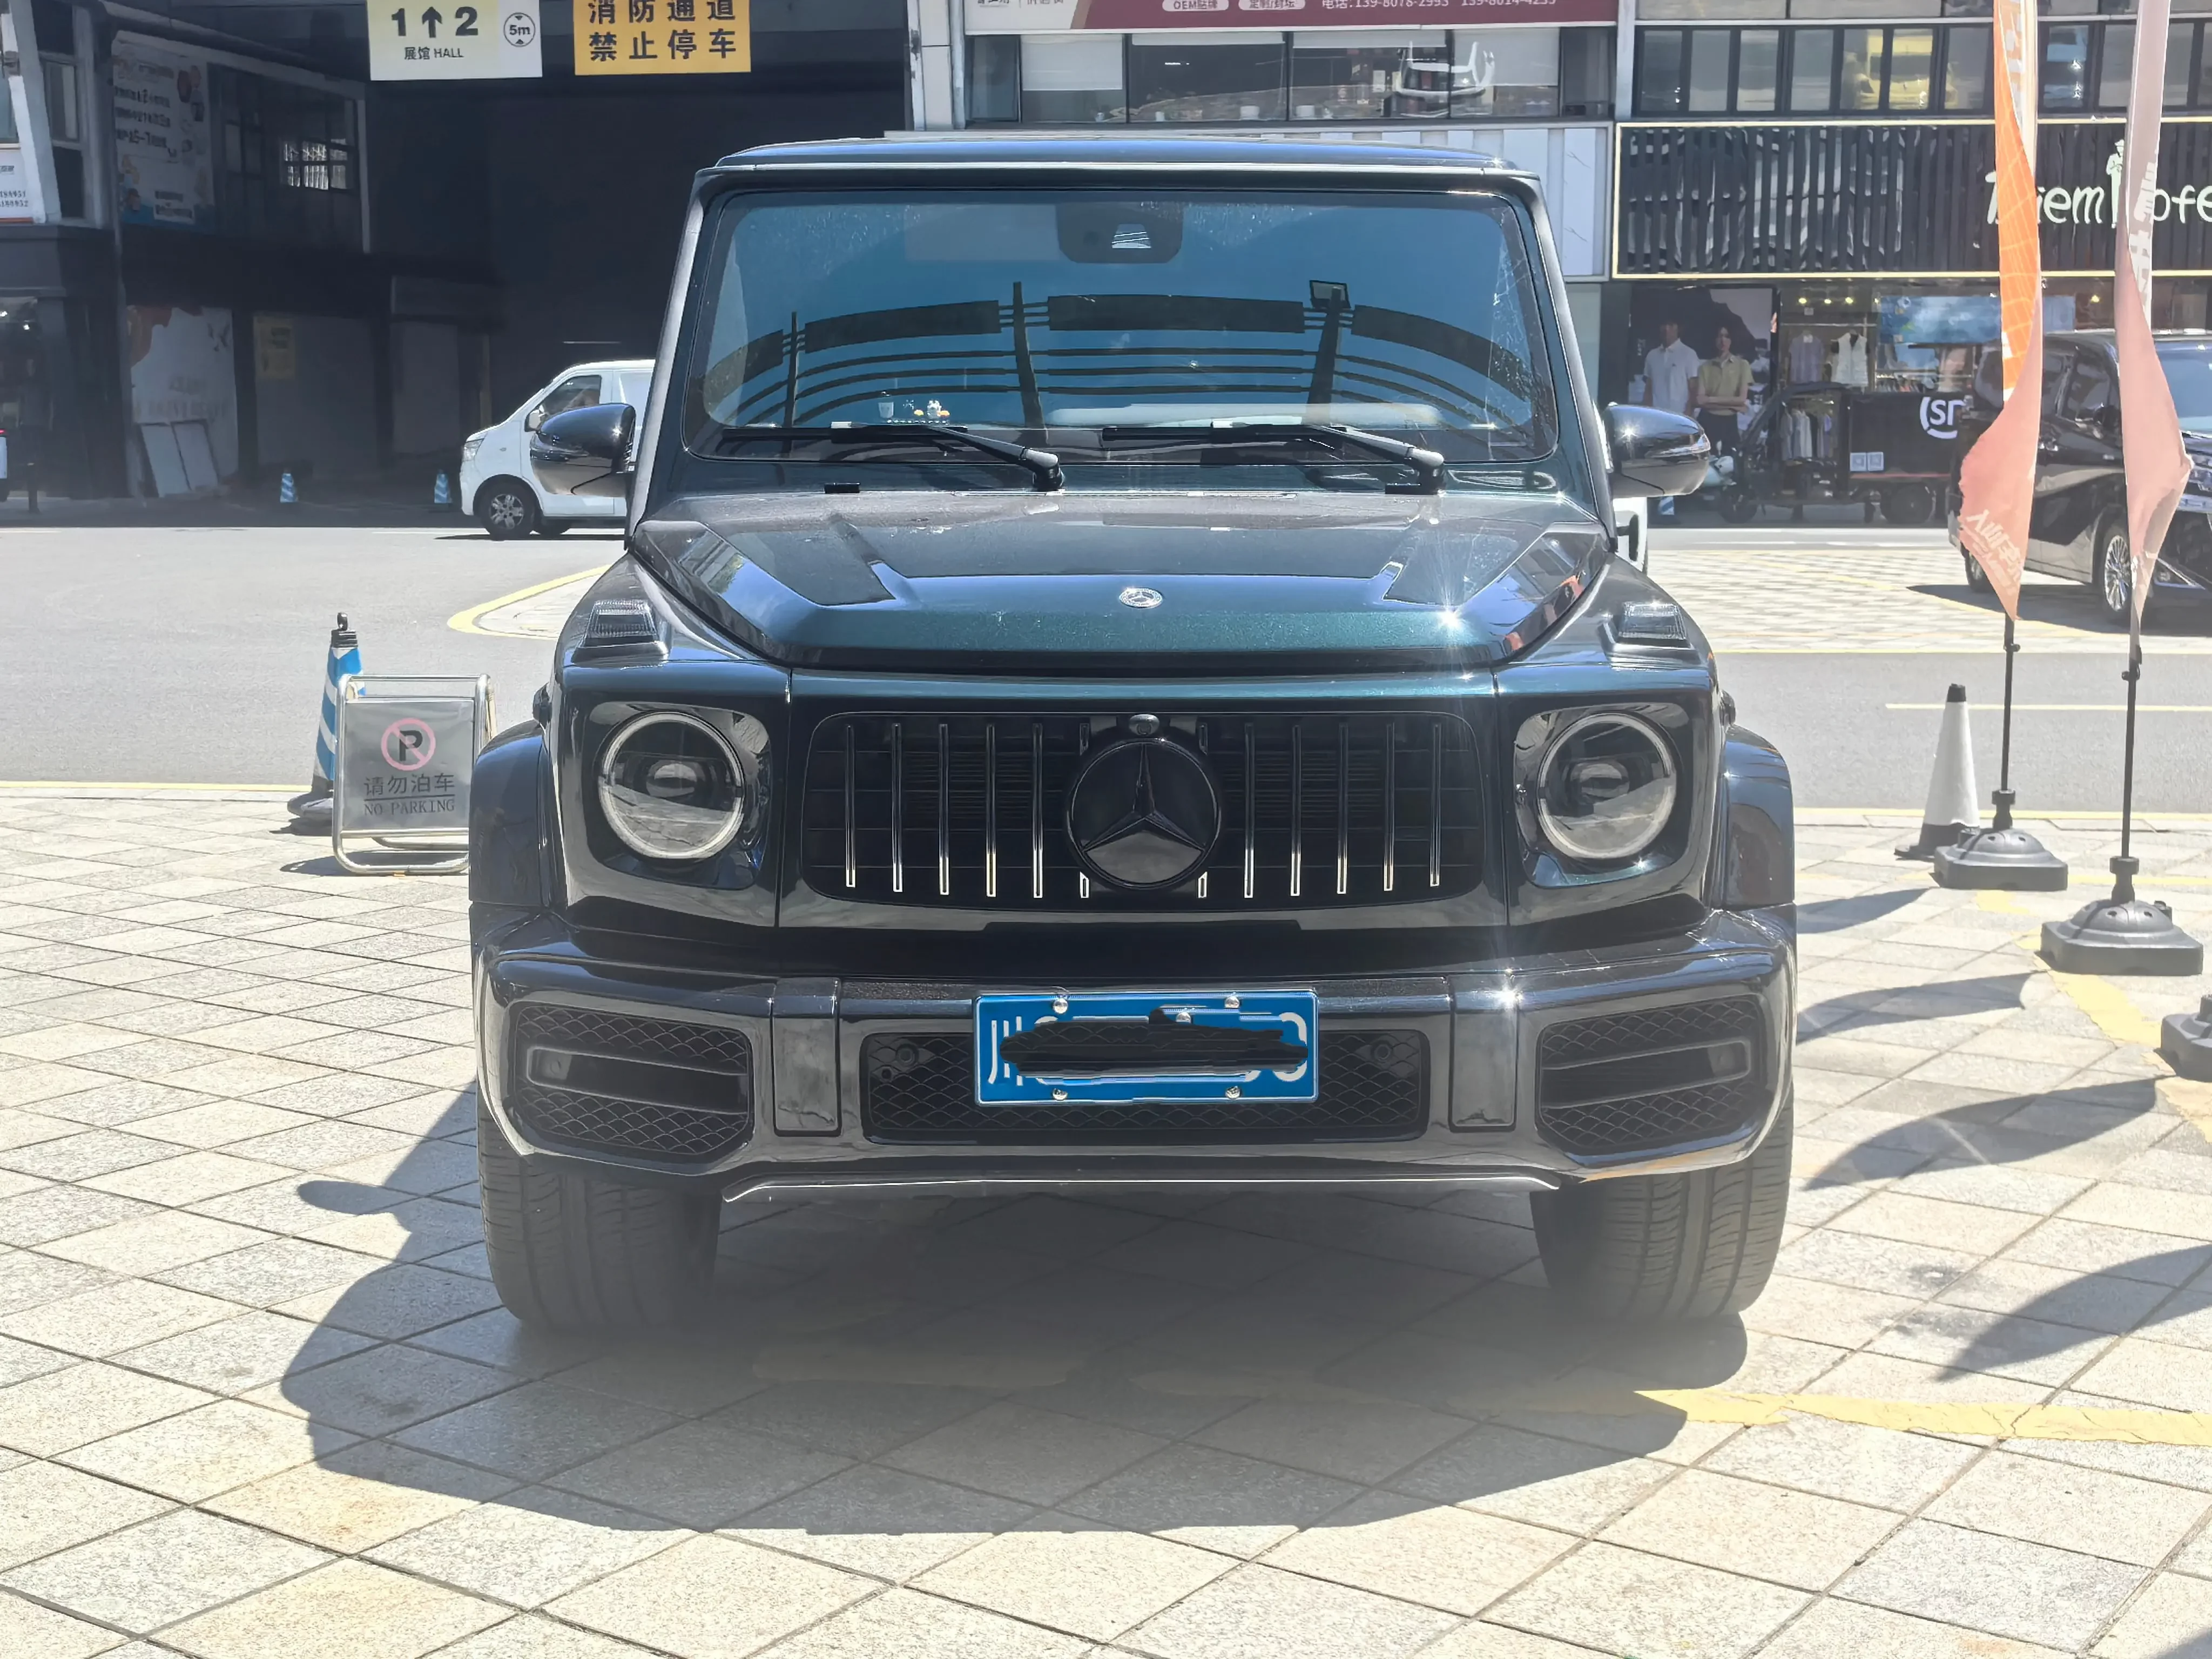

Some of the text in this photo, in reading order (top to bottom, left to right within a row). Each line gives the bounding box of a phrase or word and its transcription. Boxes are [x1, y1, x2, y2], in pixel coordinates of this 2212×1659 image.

[392, 6, 478, 36] 1 2
[588, 0, 736, 24] 消防通道
[509, 25, 531, 35] 5m
[404, 46, 464, 59] 展馆 HALL
[589, 28, 737, 62] 禁止停车
[364, 773, 455, 796] 请勿泊车
[364, 799, 455, 816] NO PARKING
